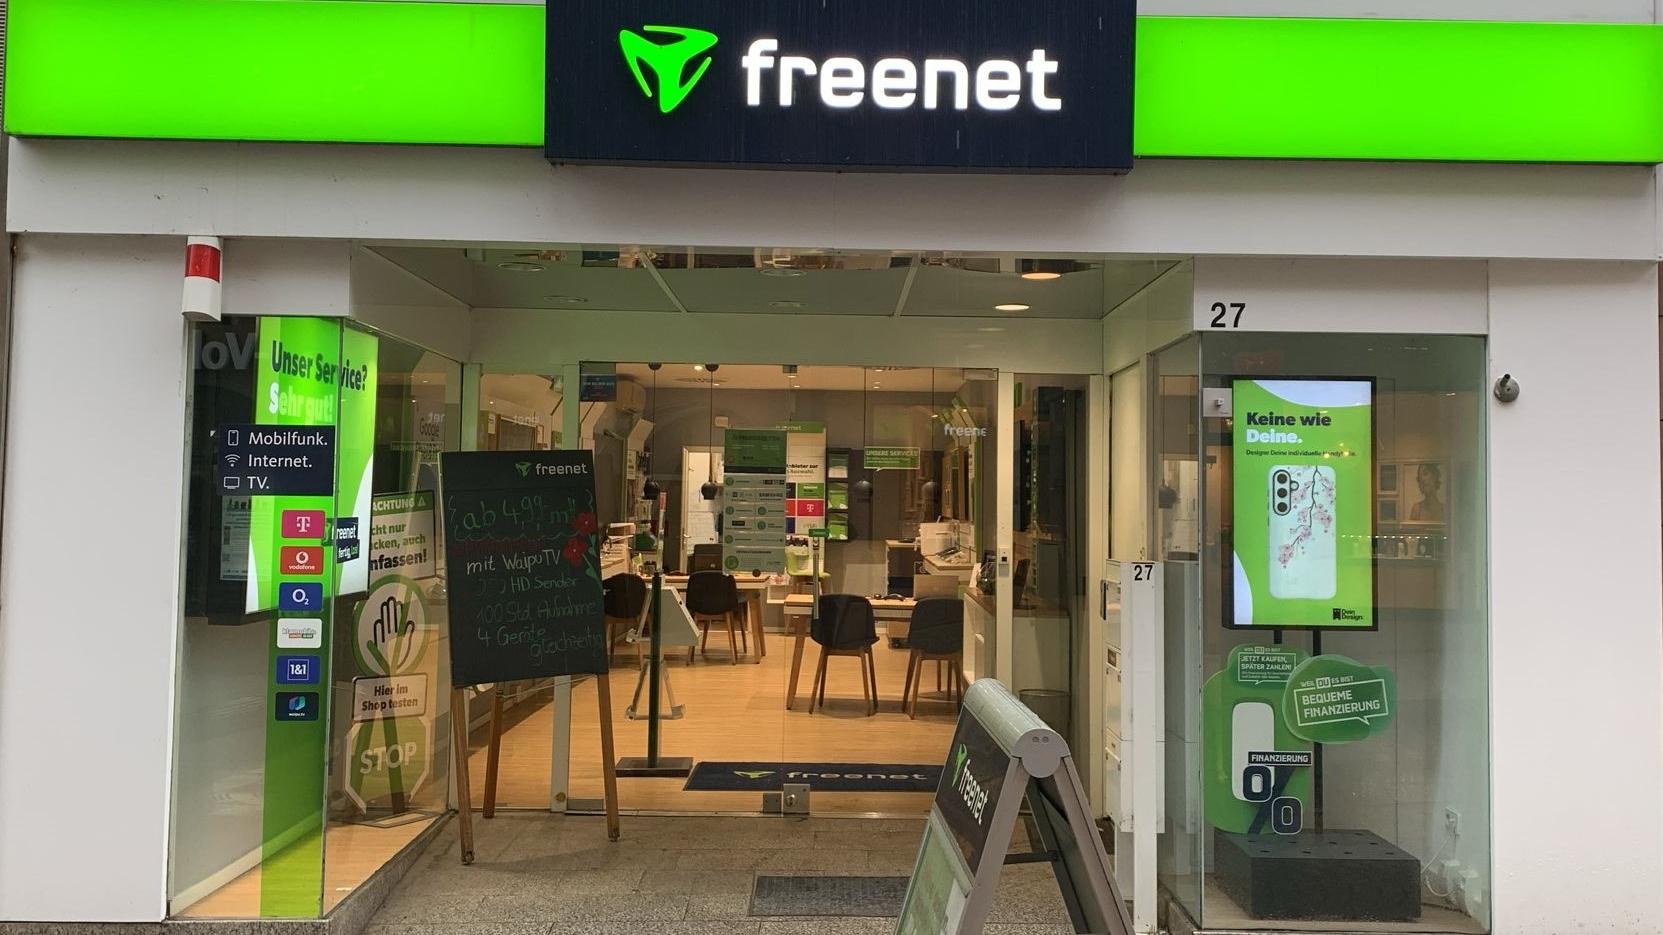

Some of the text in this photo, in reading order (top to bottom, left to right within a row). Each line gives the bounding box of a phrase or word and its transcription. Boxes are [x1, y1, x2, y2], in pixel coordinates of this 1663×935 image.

[742, 38, 1062, 111] freenet
[1210, 302, 1246, 328] 27
[272, 340, 367, 390] Unser Service?
[269, 382, 334, 424] Sehr gut!
[1247, 411, 1331, 427] Keine wie
[248, 432, 328, 446] Mobilfunk.
[1246, 429, 1303, 444] Deine.
[247, 454, 312, 468] Internet.
[535, 463, 588, 475] freenet
[247, 476, 270, 490] TV.
[463, 499, 496, 530] ab
[389, 523, 407, 534] nur
[371, 534, 426, 550] cken, auch
[466, 555, 496, 576] mit
[1133, 564, 1153, 581] 27
[510, 576, 530, 593] HD
[290, 664, 307, 675] 1&1
[1317, 678, 1330, 688] DU
[1340, 675, 1353, 683] BIST
[374, 683, 408, 697] Hier im
[1302, 690, 1353, 705] BEQUEME
[362, 698, 418, 711] Shop testen
[1304, 700, 1380, 718] FINANZIERUNG
[360, 741, 417, 774] STOP
[1251, 754, 1308, 763] FINANZIERUNG
[786, 771, 928, 780] freenet
[959, 758, 989, 825] freenet
